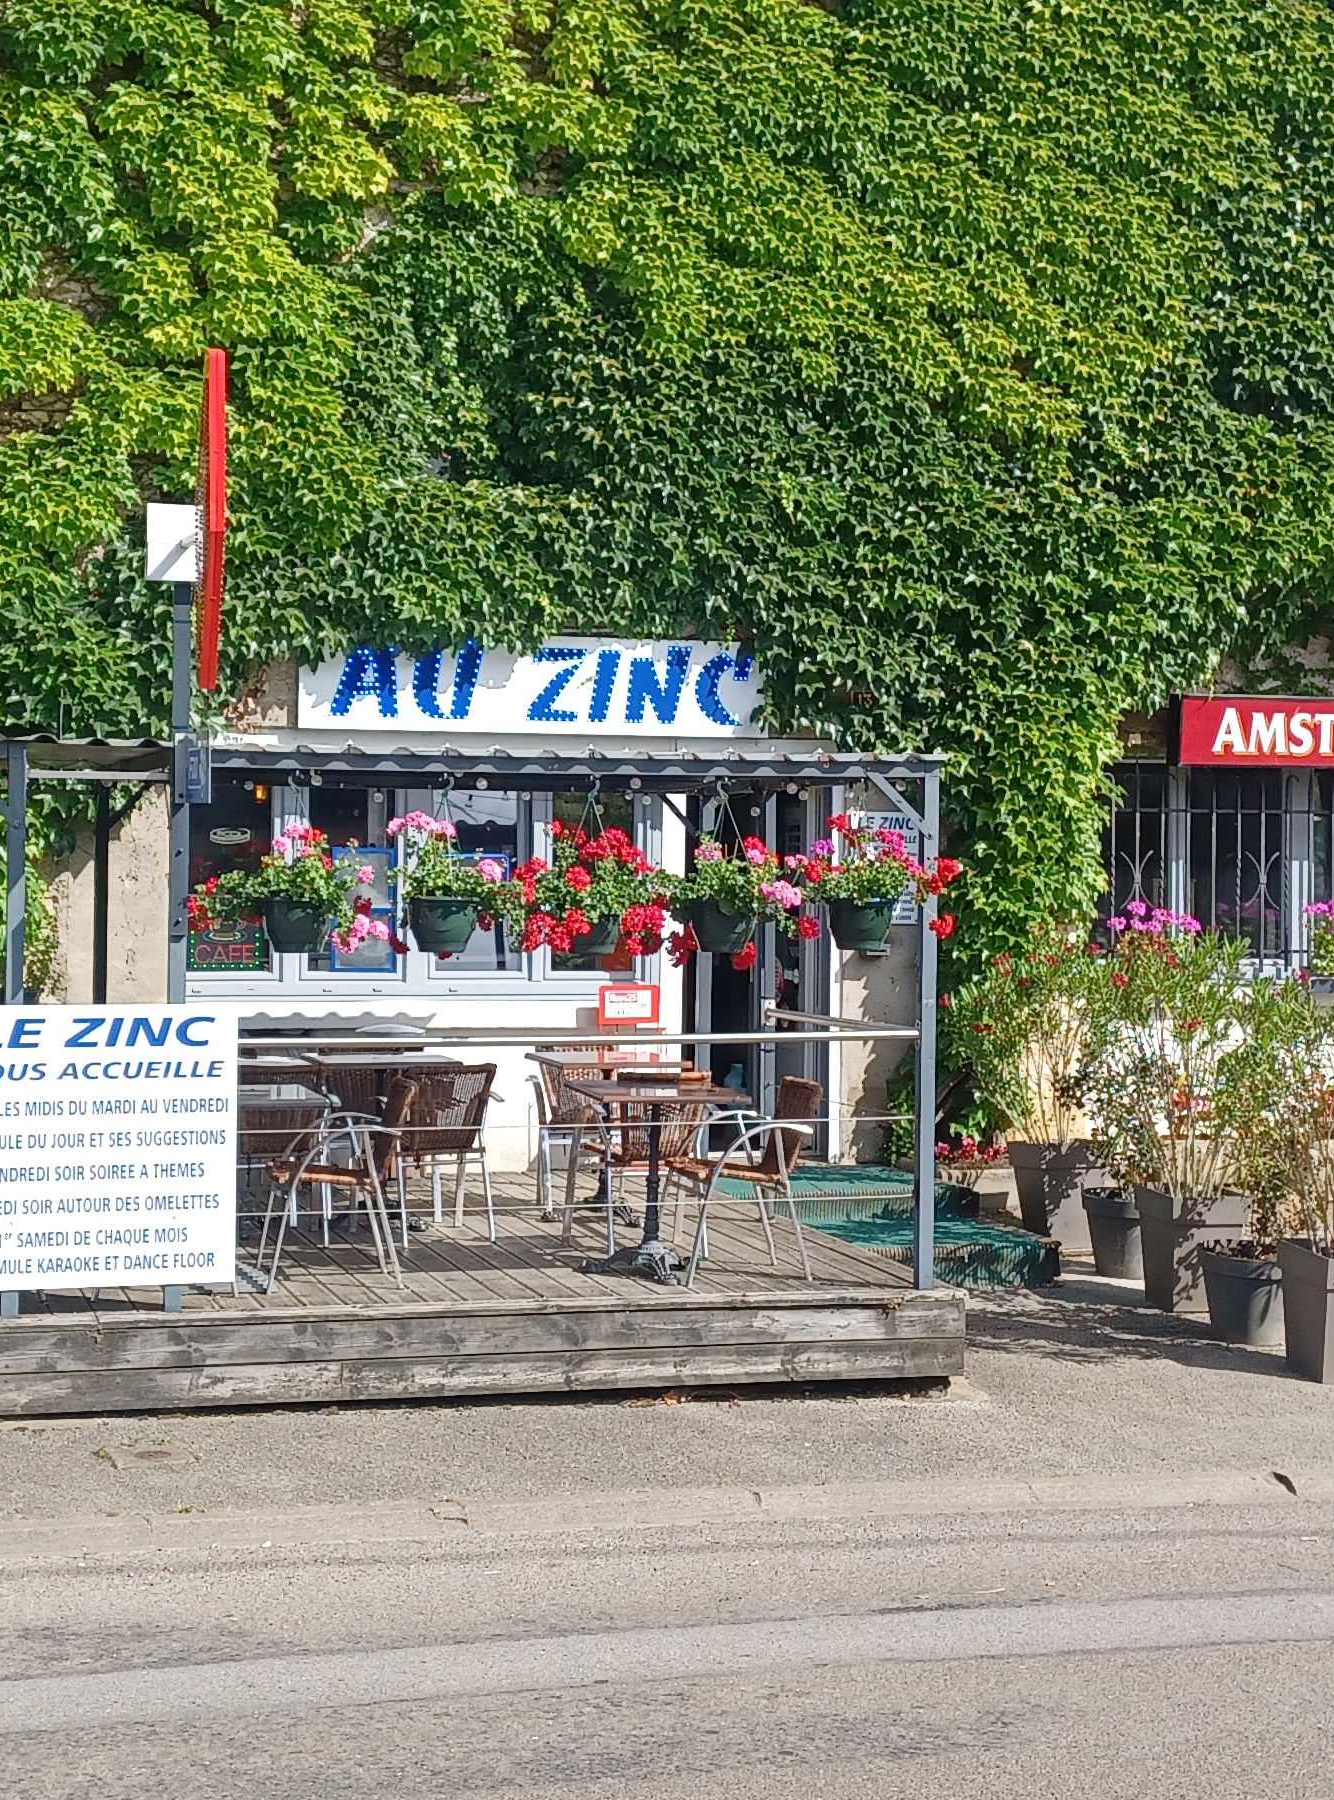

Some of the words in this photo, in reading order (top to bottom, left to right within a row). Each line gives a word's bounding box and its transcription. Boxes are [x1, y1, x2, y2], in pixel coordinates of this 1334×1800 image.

[328, 638, 485, 719] AU
[526, 644, 754, 727] ZINC
[194, 944, 255, 964] CAFE
[63, 1015, 217, 1049] ZINC
[56, 1060, 226, 1081] ACCUEILLE
[24, 1100, 64, 1117] MIDIS
[68, 1100, 88, 1116] DU
[91, 1099, 136, 1115] MARDI
[140, 1098, 158, 1114] AU
[162, 1097, 229, 1114] VENDREDI
[27, 1133, 47, 1149] DU
[50, 1133, 85, 1149] JOUR
[89, 1132, 105, 1148] ET
[108, 1131, 132, 1148] SES
[136, 1129, 226, 1147] SUGGESTIONS
[54, 1165, 85, 1182] SOIR
[89, 1163, 135, 1181] SOIREE
[139, 1163, 149, 1179] A
[152, 1161, 205, 1179] THEMES
[22, 1199, 53, 1215] SOIR
[56, 1197, 111, 1214] AUTOUR
[115, 1195, 140, 1212] DES
[144, 1193, 220, 1211] OMELETTES
[16, 1231, 69, 1248] SAMEDI
[73, 1230, 91, 1246] DE
[95, 1228, 150, 1247] CHAQUE
[154, 1226, 188, 1244] MOIS
[37, 1256, 100, 1274] KARAOKE
[104, 1255, 120, 1271] ET
[123, 1253, 169, 1270] DANCE
[173, 1252, 215, 1269] FLOOR
